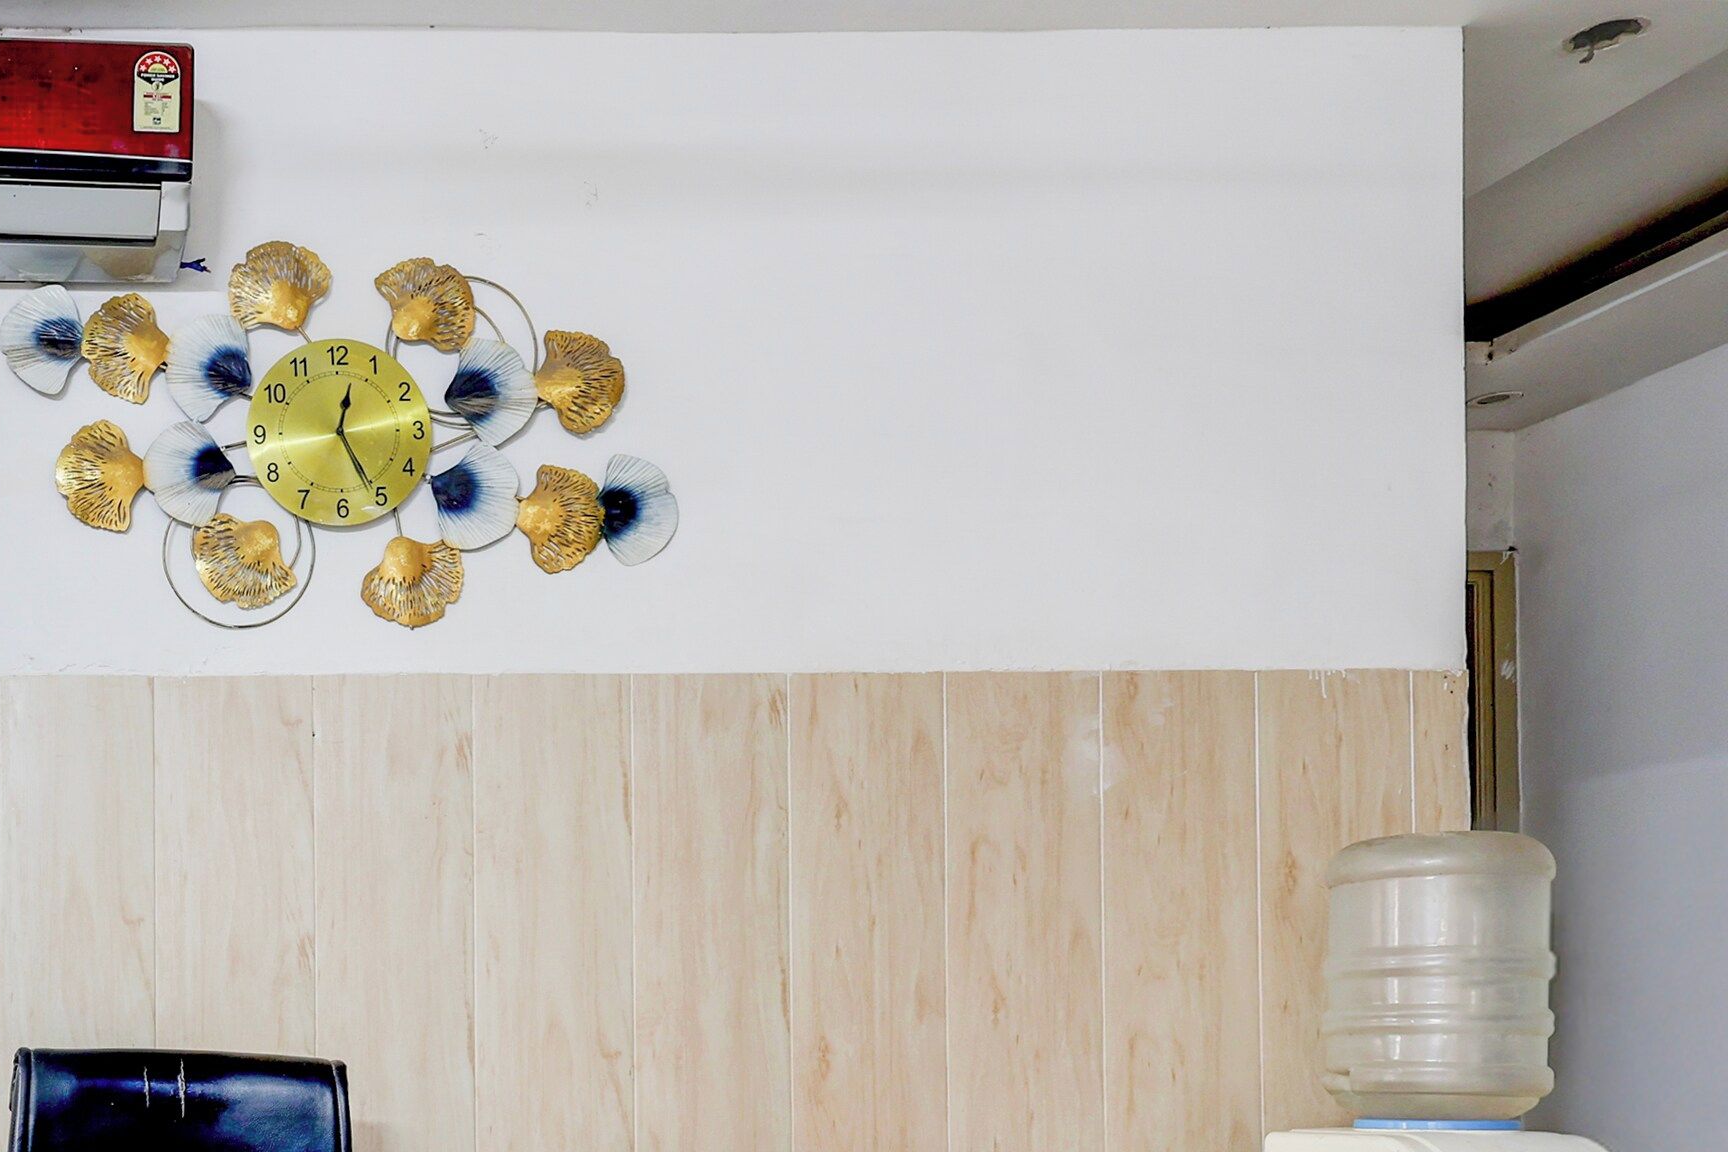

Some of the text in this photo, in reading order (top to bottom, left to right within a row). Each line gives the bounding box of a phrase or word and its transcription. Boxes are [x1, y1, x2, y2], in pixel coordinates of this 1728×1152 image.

[327, 345, 349, 365] 12
[369, 355, 378, 375] 1
[289, 357, 308, 377] 11
[263, 383, 286, 403] 10
[398, 381, 411, 401] 2
[253, 424, 267, 444] 9
[412, 420, 425, 440] 3
[266, 462, 280, 482] 8
[402, 457, 415, 477] 4
[297, 489, 311, 510] 7
[375, 486, 387, 506] 5
[336, 498, 350, 518] 6
